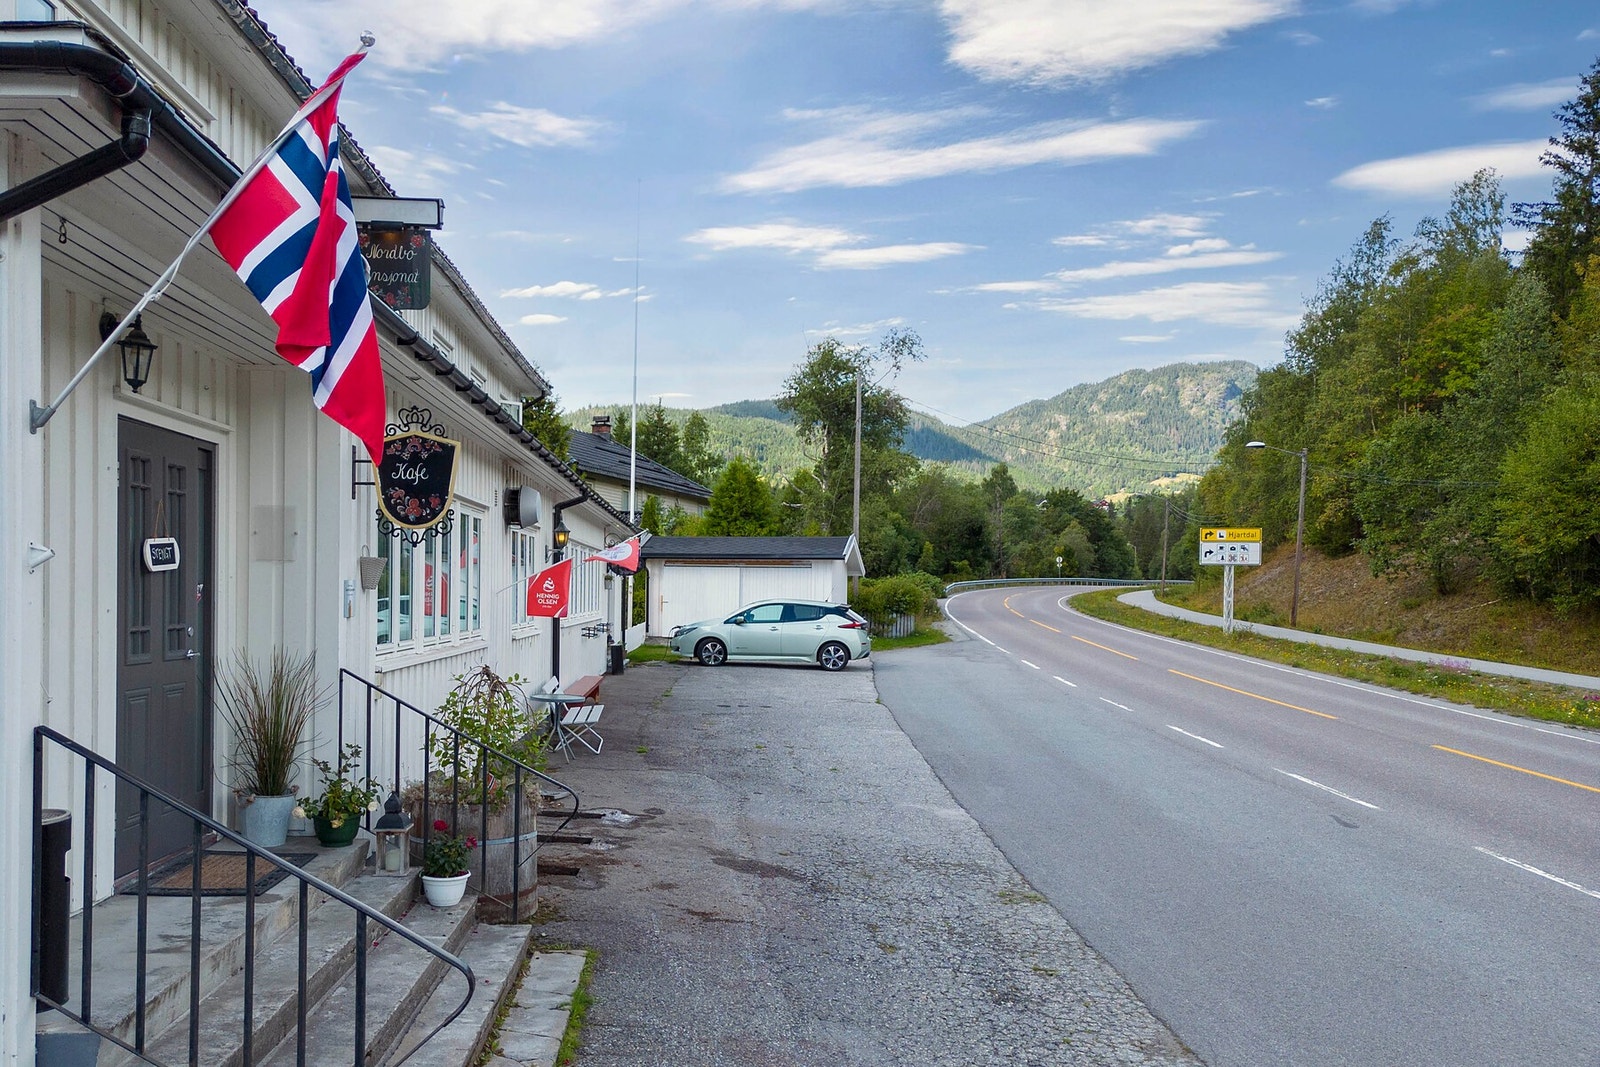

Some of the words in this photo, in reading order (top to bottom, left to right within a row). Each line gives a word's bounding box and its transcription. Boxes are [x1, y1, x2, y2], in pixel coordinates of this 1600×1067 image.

[366, 243, 417, 260] Nordbo
[371, 269, 419, 286] nsjonat
[391, 463, 429, 485] Kafe
[151, 547, 172, 560] STENGT
